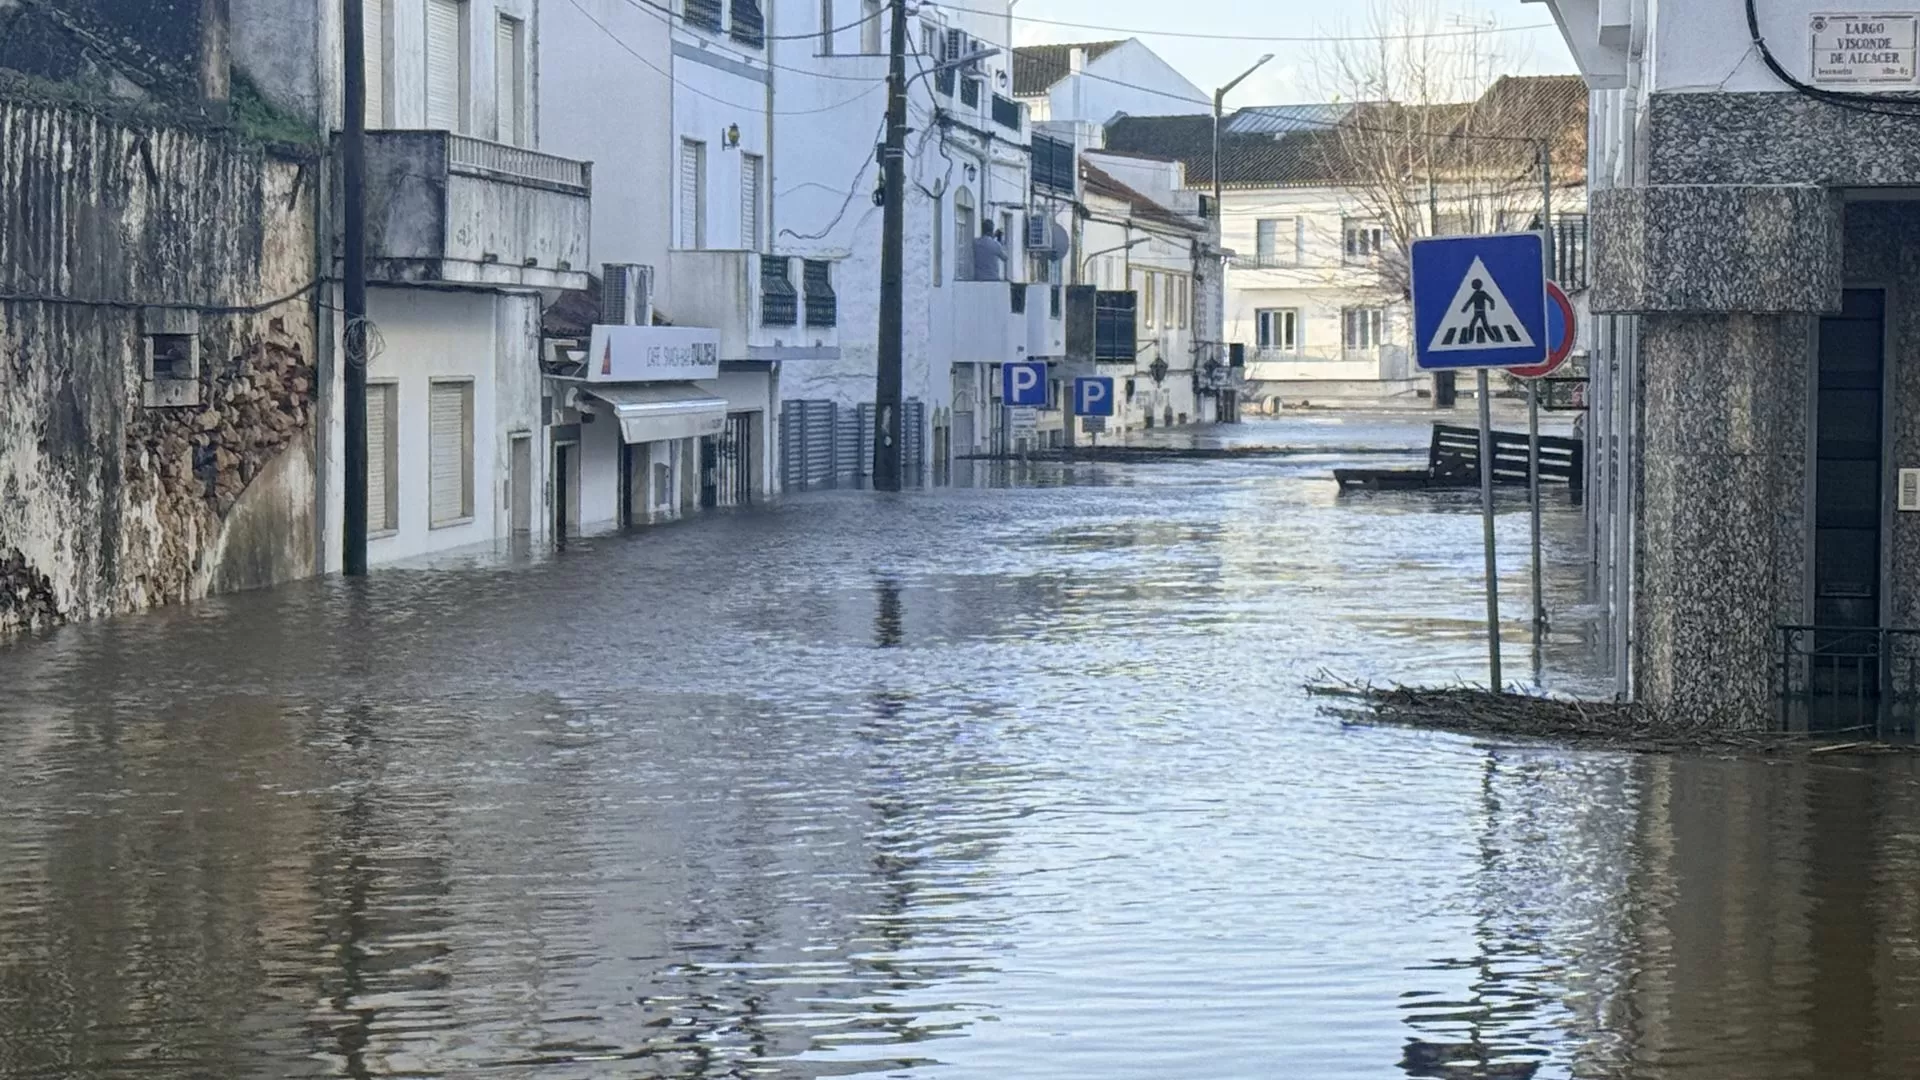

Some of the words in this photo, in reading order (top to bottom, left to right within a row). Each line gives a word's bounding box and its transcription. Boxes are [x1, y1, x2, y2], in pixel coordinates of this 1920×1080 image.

[1845, 23, 1885, 34] LARGO
[1837, 37, 1892, 49] VISCONDE
[1830, 53, 1844, 64] DE
[1012, 366, 1037, 402] P
[1083, 380, 1105, 412] P
